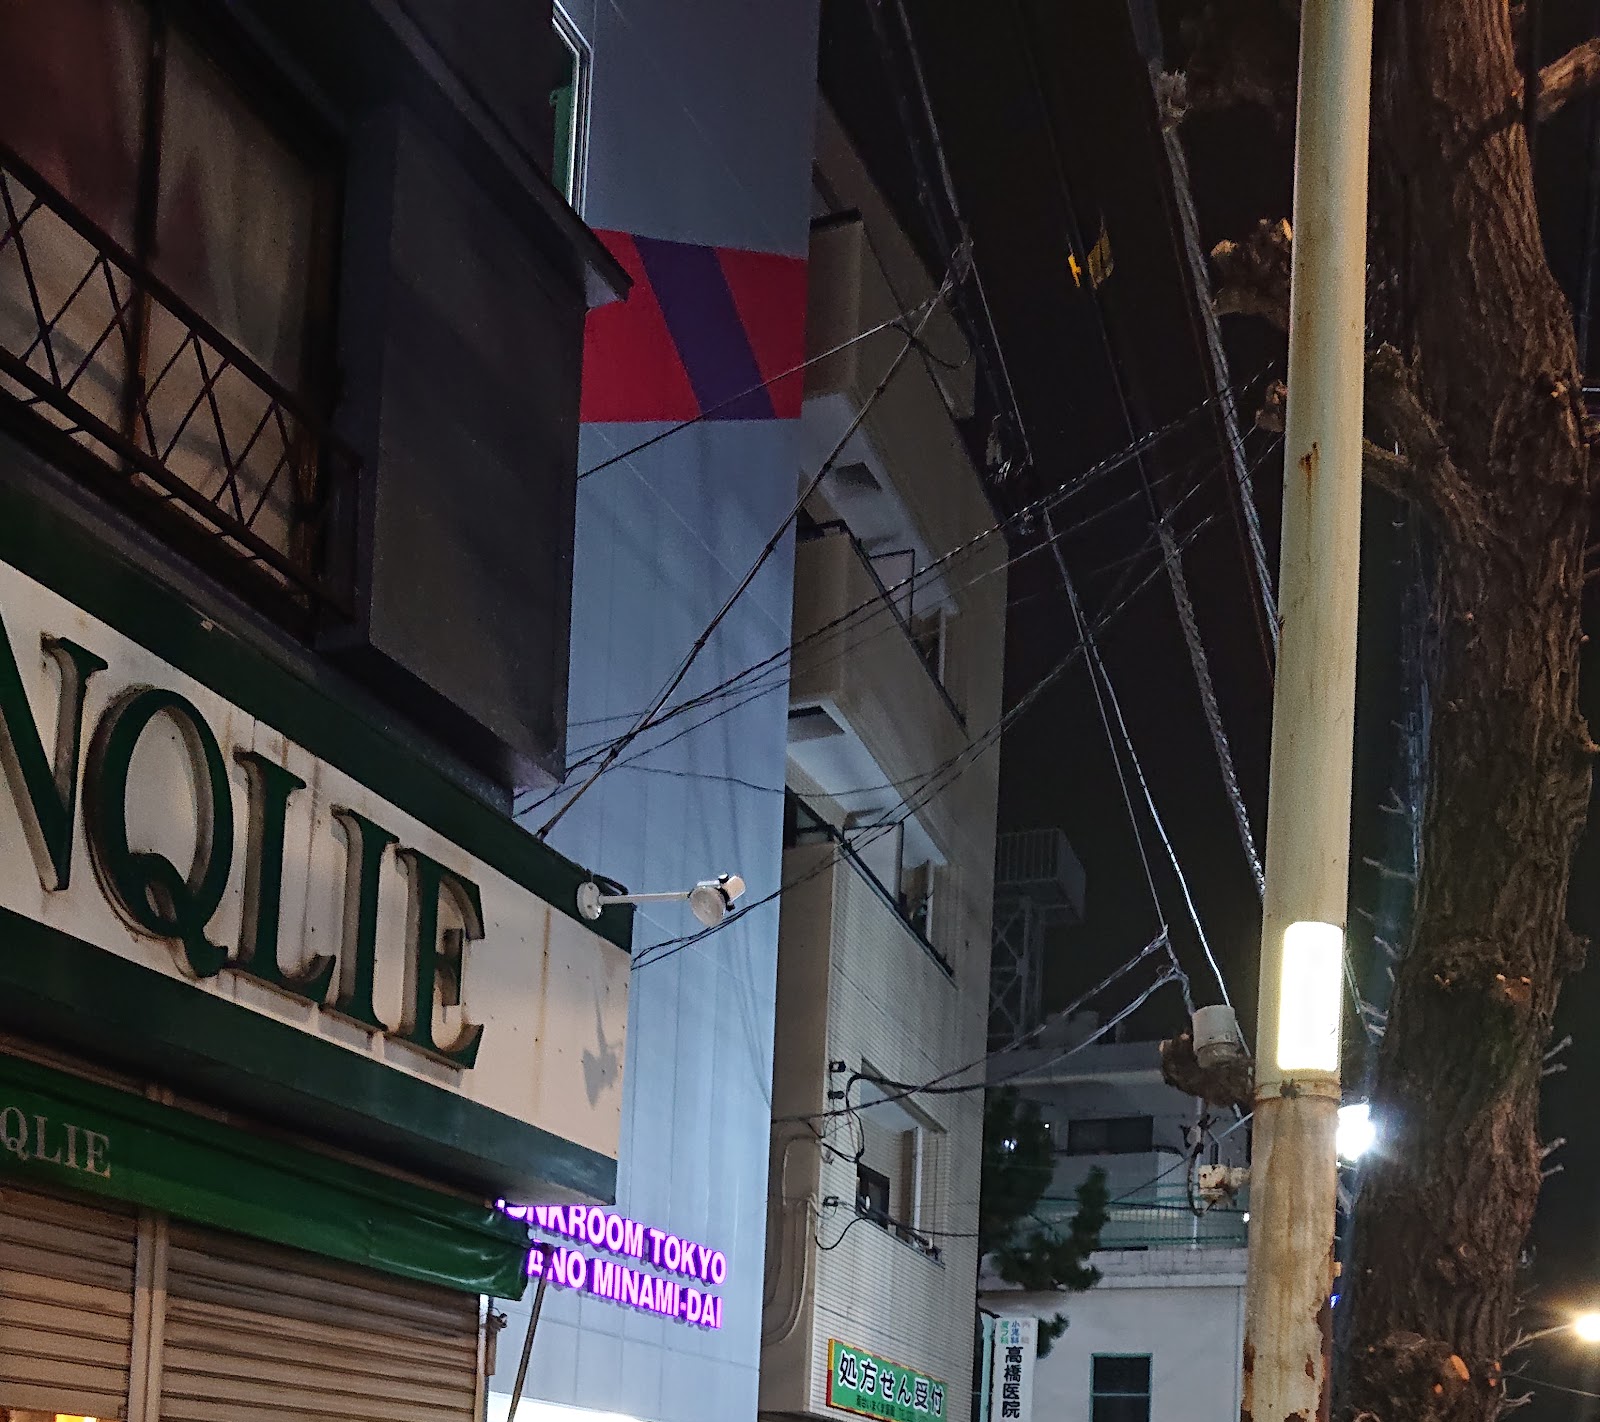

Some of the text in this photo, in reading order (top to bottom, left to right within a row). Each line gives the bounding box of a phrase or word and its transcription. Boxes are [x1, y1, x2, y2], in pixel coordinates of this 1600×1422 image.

[0, 1107, 111, 1178] QLIE
[648, 1227, 728, 1285] TOKYO
[590, 1257, 723, 1330] MINAMI-DAI
[838, 1348, 944, 1417] 処方せん受付
[1002, 1346, 1023, 1419] 高橋医院
